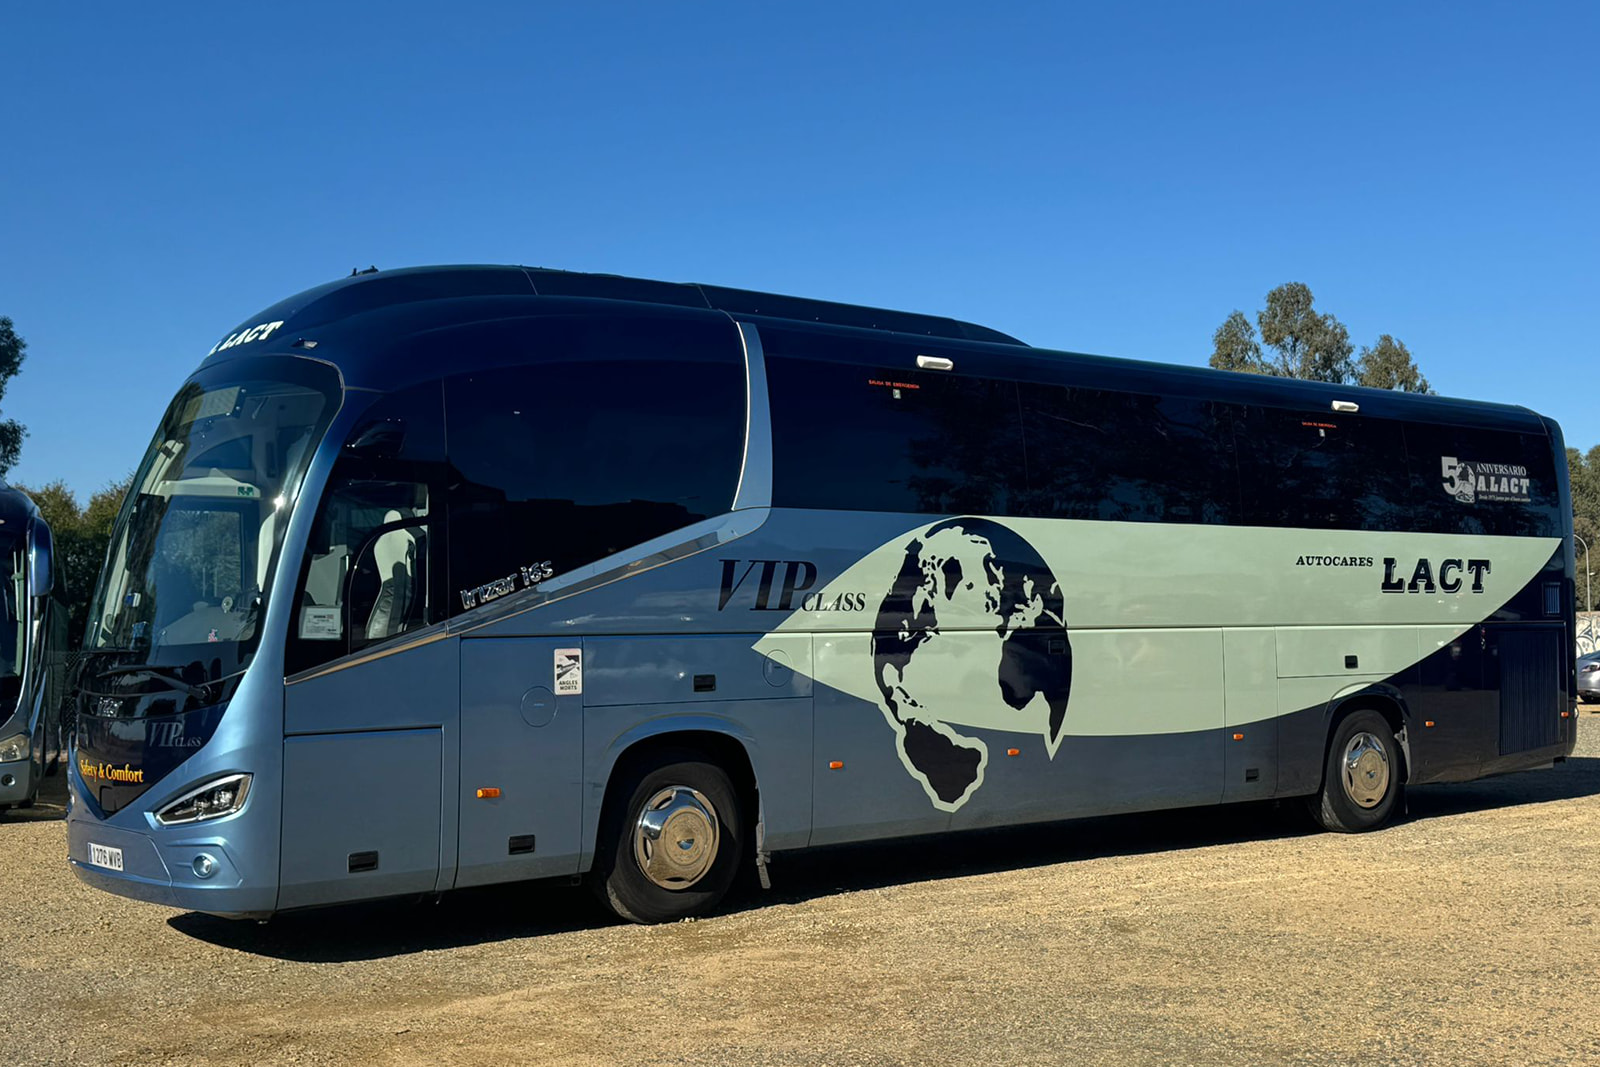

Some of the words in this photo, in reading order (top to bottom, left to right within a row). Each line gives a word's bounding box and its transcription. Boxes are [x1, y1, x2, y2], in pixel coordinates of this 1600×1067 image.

[1476, 463, 1527, 476] ANIVERSARIO
[1296, 555, 1374, 567] AUTOCARES
[718, 559, 817, 611] VIP
[1381, 557, 1491, 594] LACT
[801, 592, 866, 612] CLASS
[149, 721, 185, 747] VIP
[80, 759, 98, 782] Safety
[98, 762, 105, 778] &
[106, 763, 144, 783] Comfort
